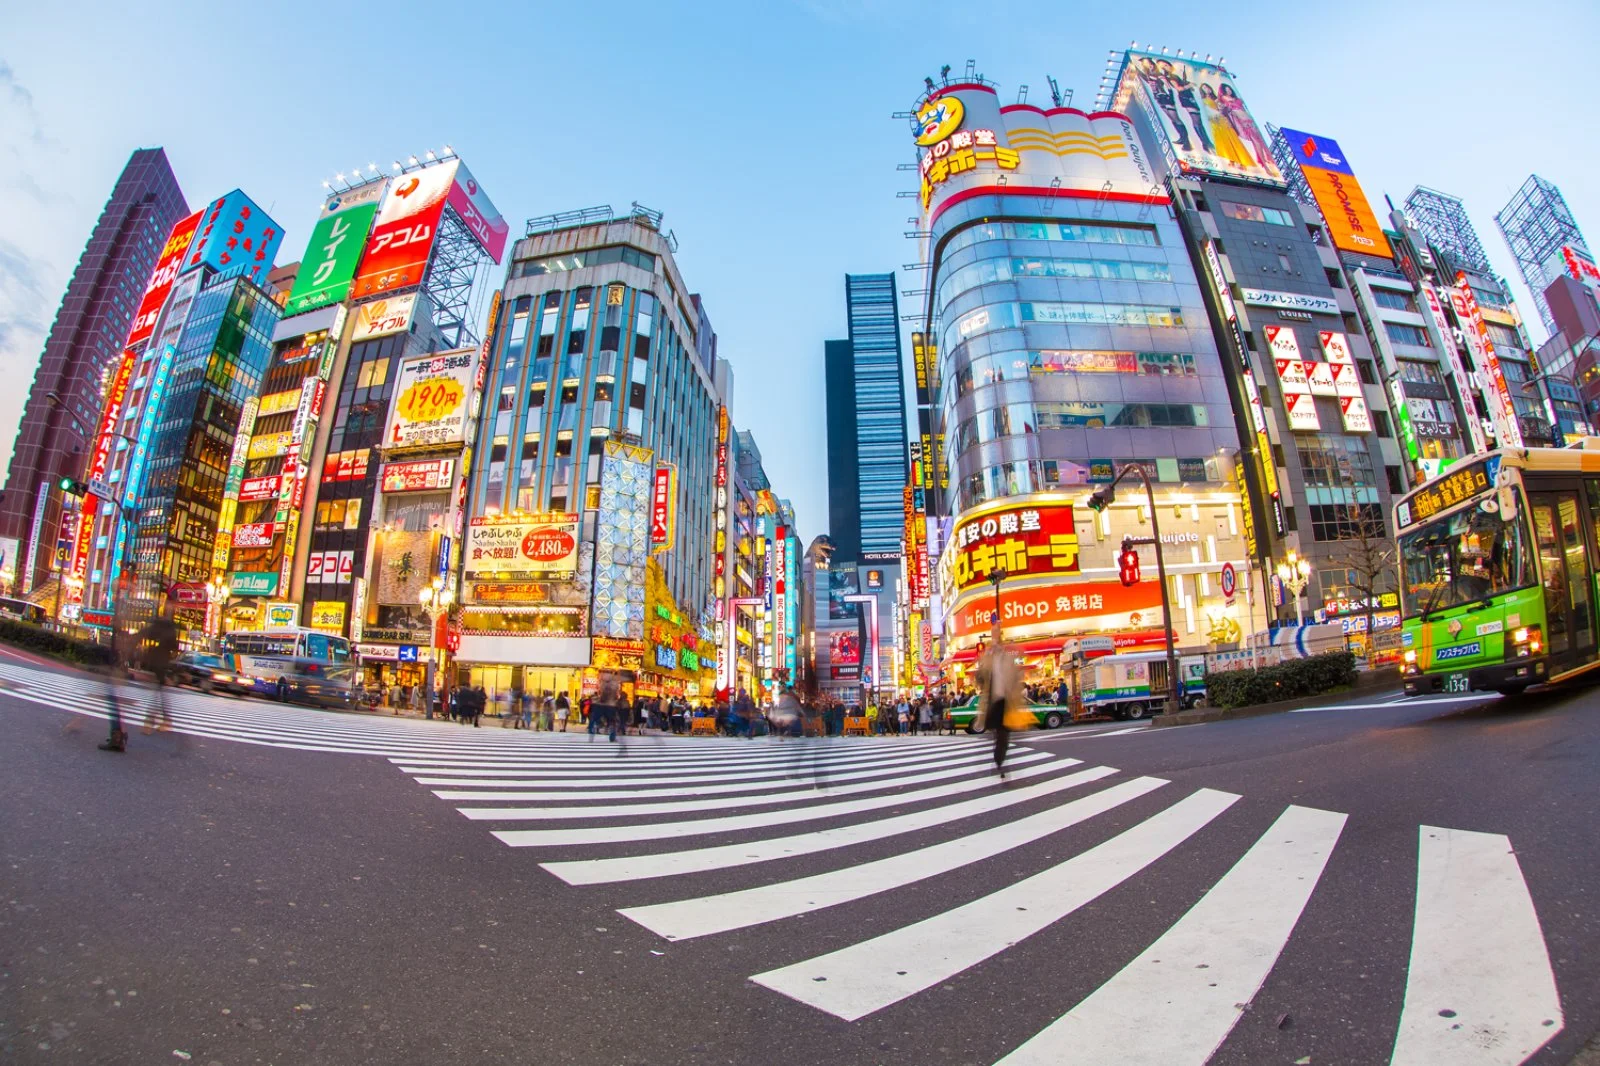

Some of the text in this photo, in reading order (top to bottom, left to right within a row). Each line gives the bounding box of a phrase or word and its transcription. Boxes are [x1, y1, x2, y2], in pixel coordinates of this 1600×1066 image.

[1121, 121, 1149, 183] Don Quijote
[1326, 171, 1364, 233] PROMISE
[463, 202, 489, 244] アコム
[371, 223, 431, 255] アコム
[311, 216, 351, 286] レイク
[1280, 310, 1313, 319] SQUARE
[367, 316, 407, 334] アイフル
[407, 384, 458, 411] 190円
[439, 477, 450, 486] 1F
[472, 527, 523, 539] しゃぶしゃぶ
[1159, 531, 1199, 546] uijote
[309, 555, 353, 574] アコム
[775, 539, 785, 582] SHIDAX
[1004, 599, 1050, 620] Shop
[1055, 593, 1104, 613] 免税店
[1326, 601, 1337, 613] 4F
[1437, 643, 1480, 660] ノンステップバス
[1448, 677, 1469, 692] 13-67
